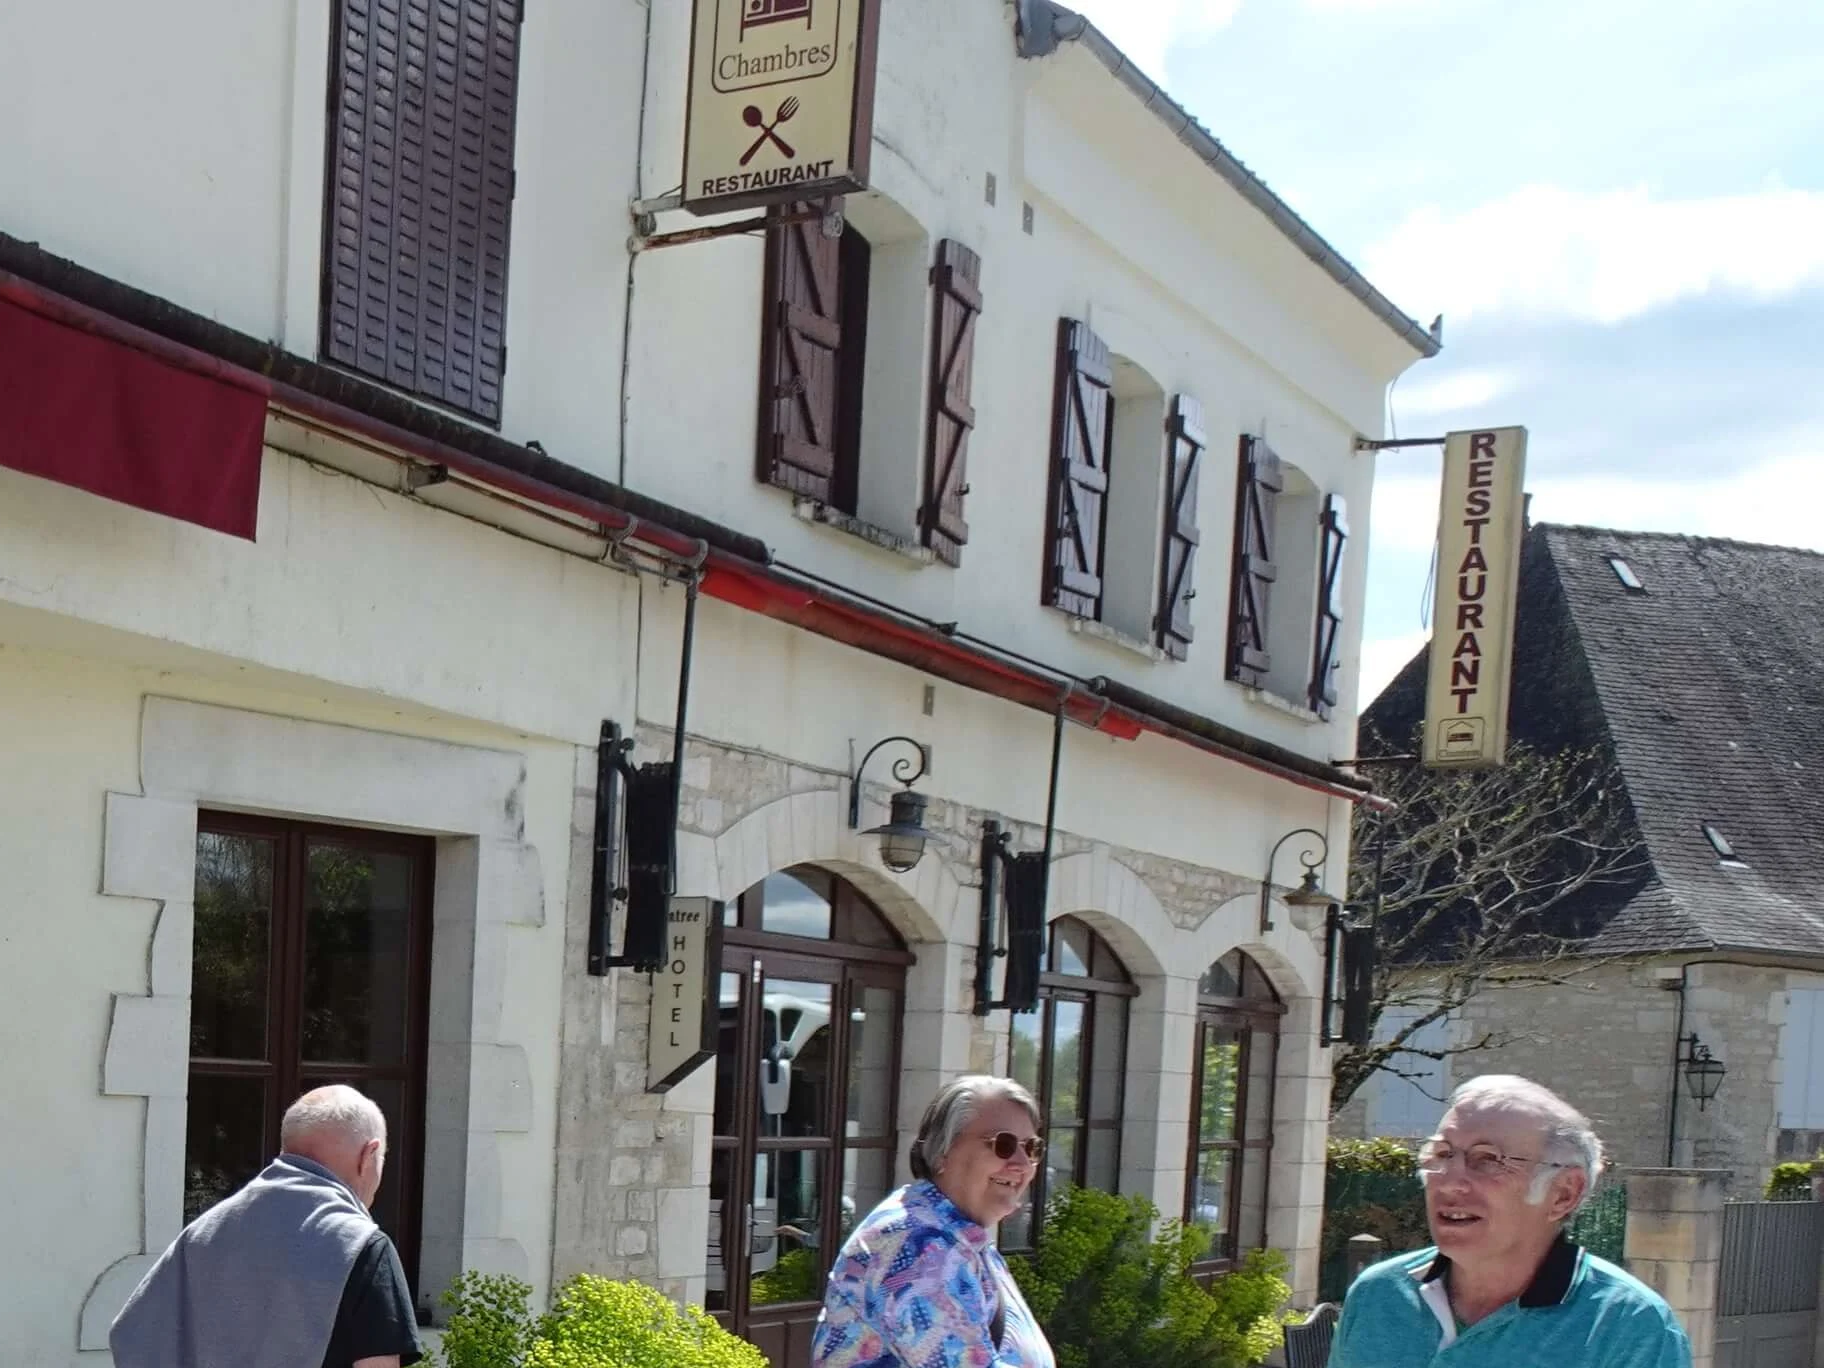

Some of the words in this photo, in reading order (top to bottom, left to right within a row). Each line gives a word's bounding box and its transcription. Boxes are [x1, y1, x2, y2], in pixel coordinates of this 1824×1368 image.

[719, 44, 831, 80] Chambres
[702, 160, 834, 196] RESTAURANT
[1450, 432, 1497, 715] RESTAURANT
[670, 935, 686, 1047] HOTEL
